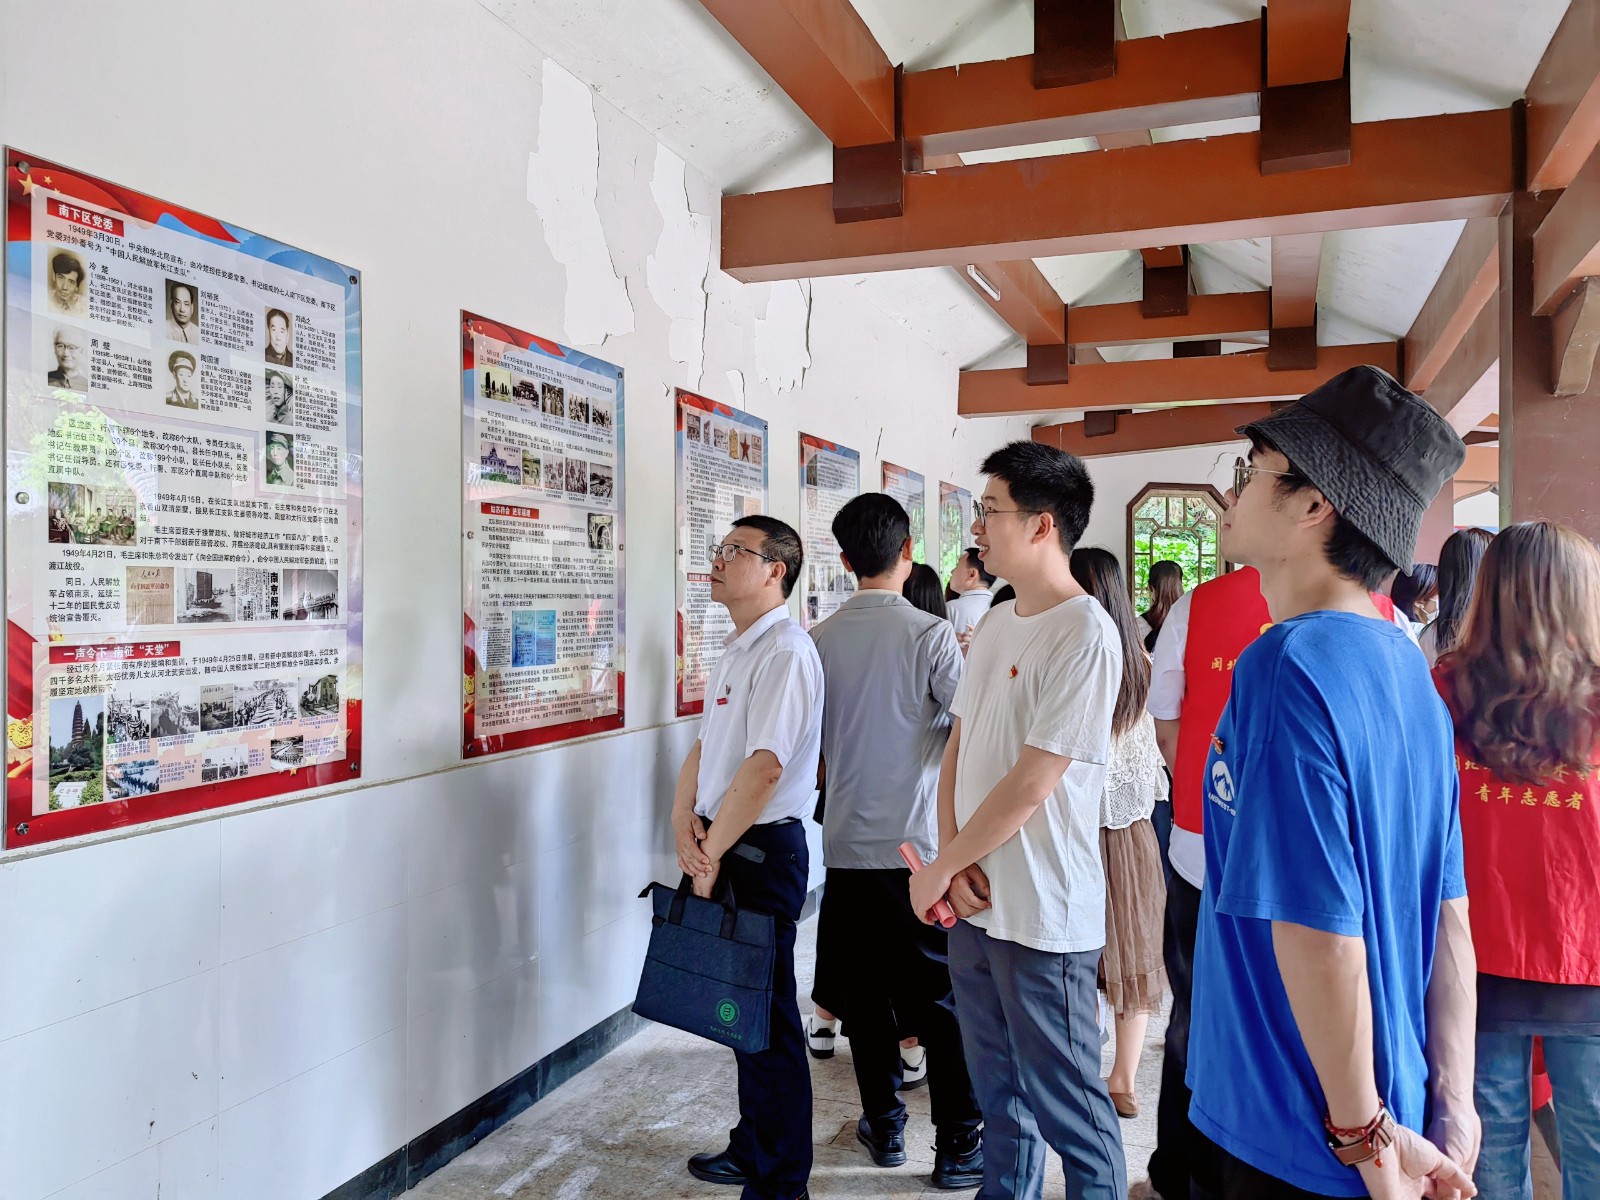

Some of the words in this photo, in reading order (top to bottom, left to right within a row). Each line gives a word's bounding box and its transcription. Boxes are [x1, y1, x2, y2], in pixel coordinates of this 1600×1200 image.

[58, 202, 113, 232] 南下区党委
[48, 600, 120, 610] 十二年的国民党反动
[269, 571, 279, 620] 南京解放
[63, 646, 108, 661] 一声令下
[1475, 783, 1584, 811] 青年志愿者
